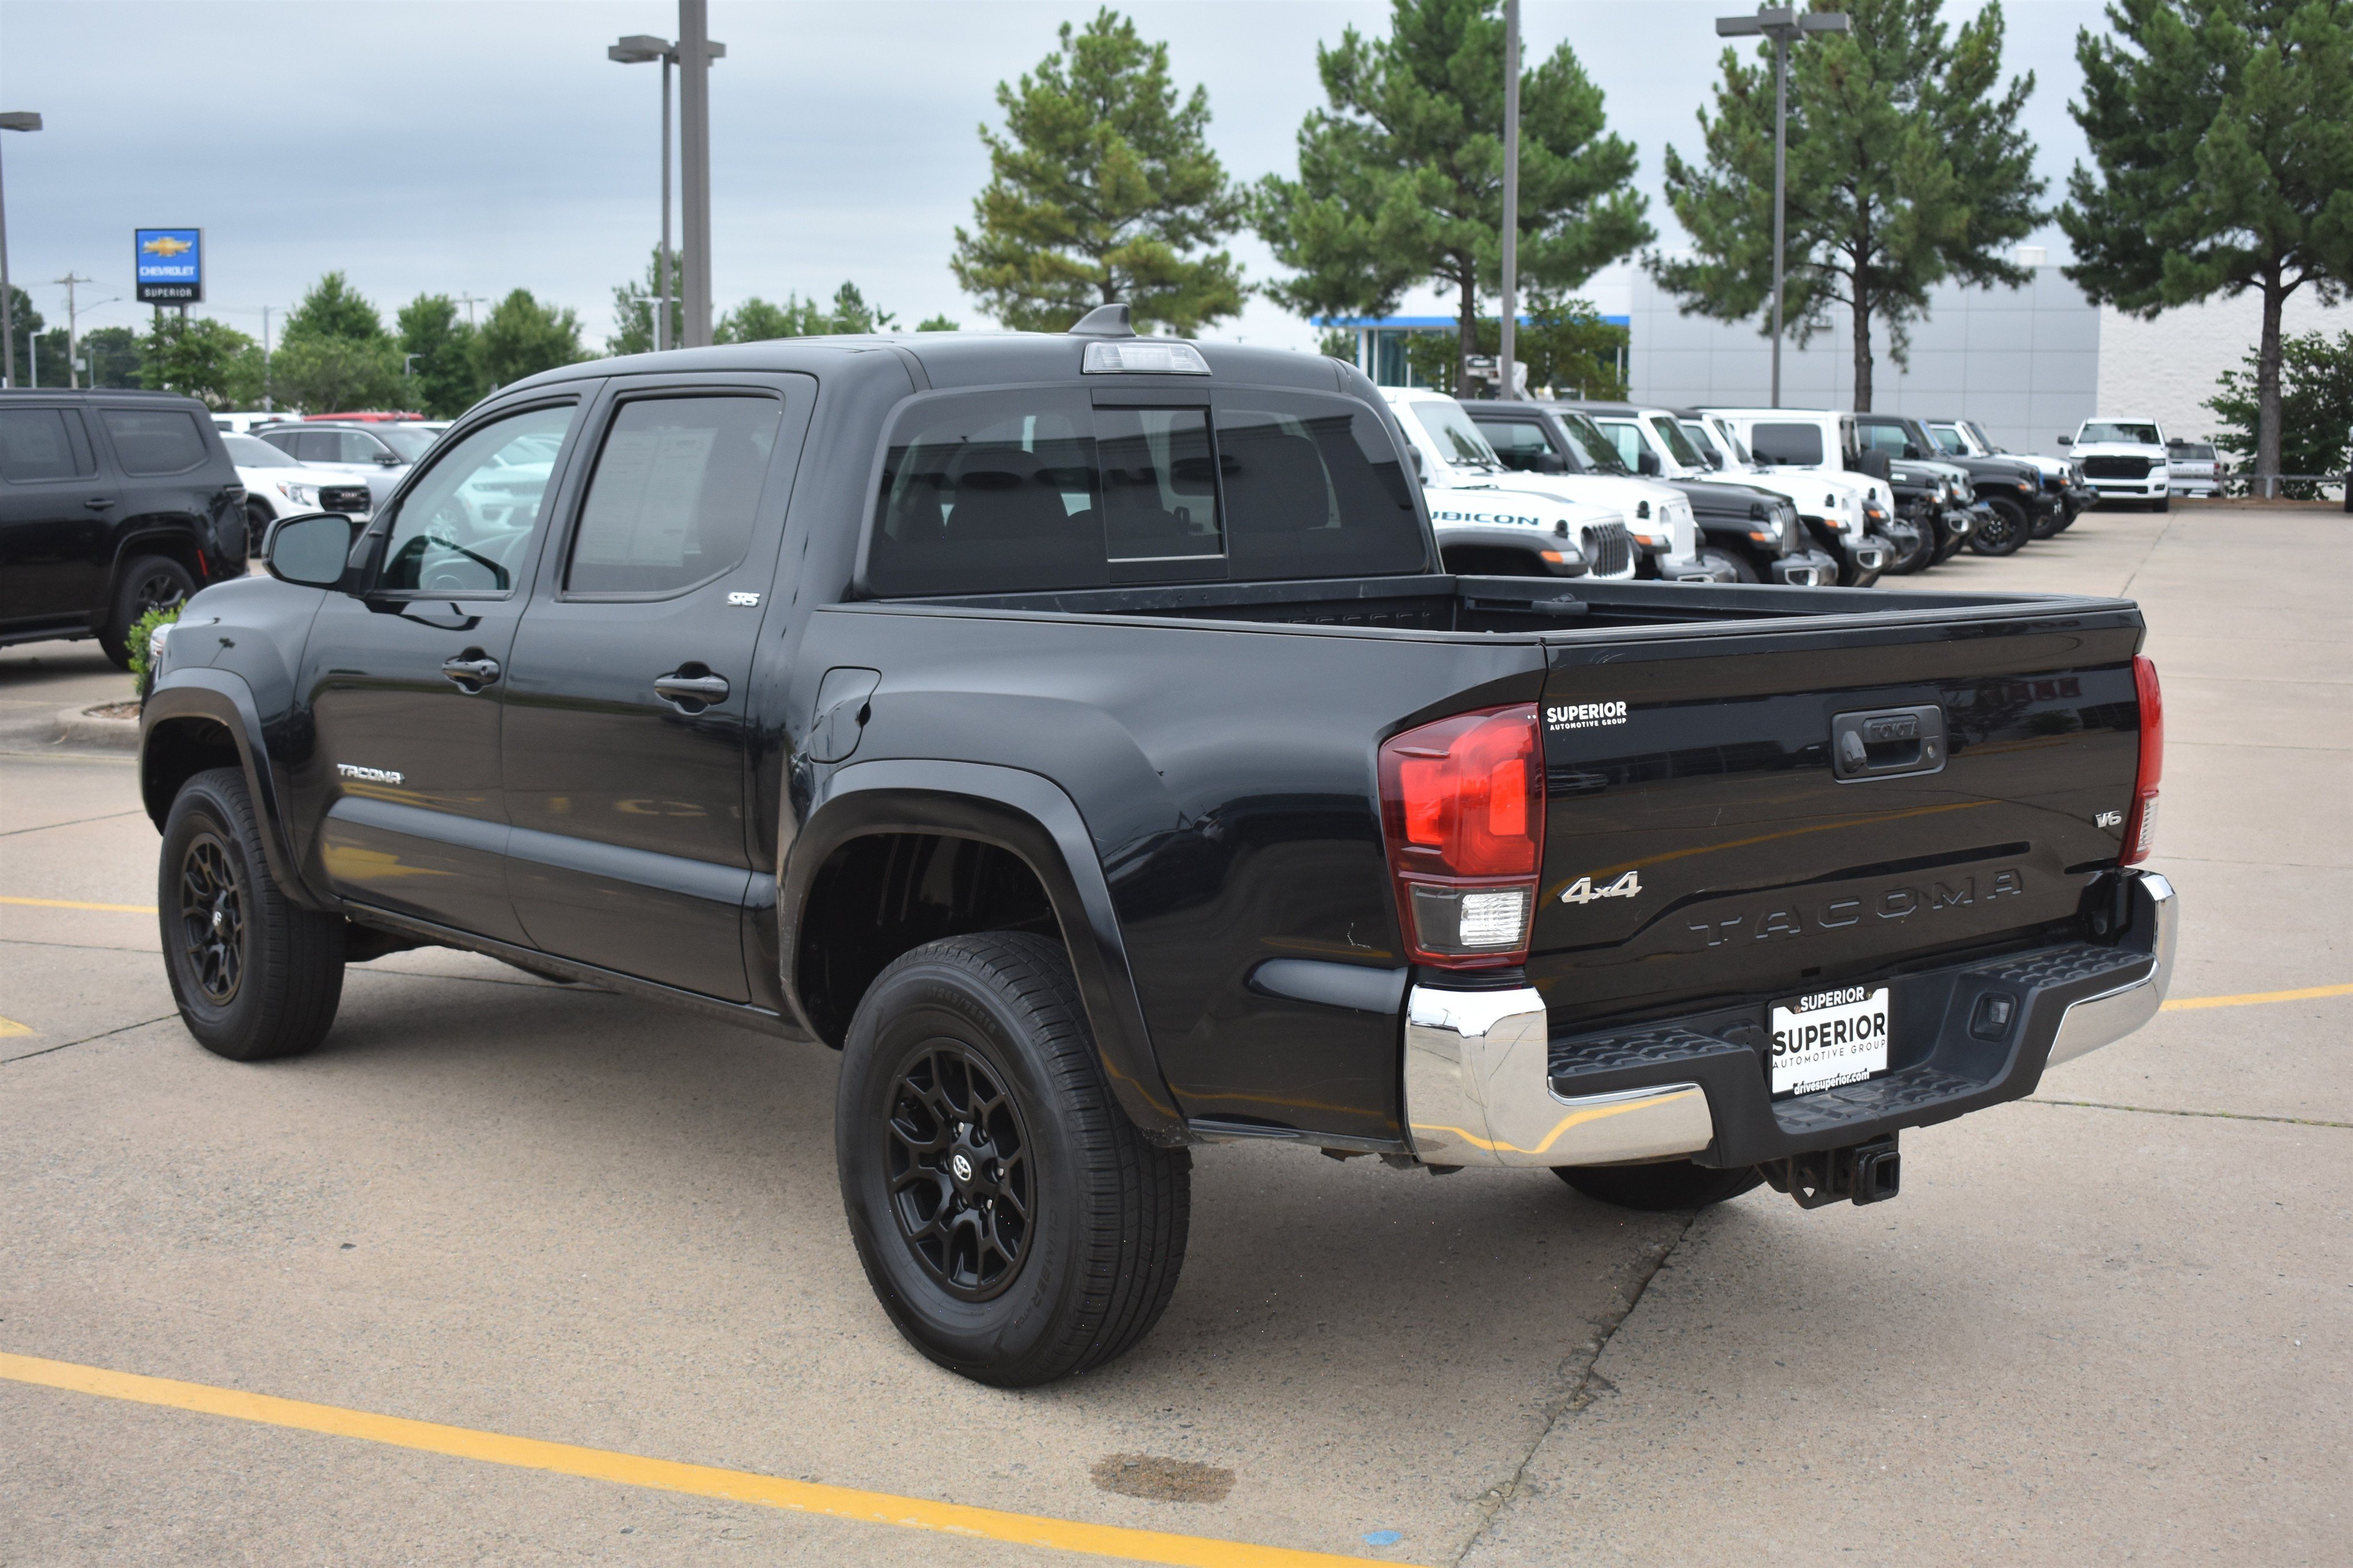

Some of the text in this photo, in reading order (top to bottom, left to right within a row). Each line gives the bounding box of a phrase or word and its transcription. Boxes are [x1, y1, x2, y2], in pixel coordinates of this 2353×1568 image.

[139, 266, 194, 276] CHEVROLET
[145, 288, 192, 298] SUPERIOR
[1432, 511, 1540, 526] BICON
[728, 592, 761, 607] SR5
[1546, 701, 1627, 723] SUPERIOR
[1550, 717, 1627, 731] AUTOMOTIVE GROUP
[337, 763, 402, 785] TACOMA
[2094, 810, 2121, 828] V6
[1558, 870, 1642, 904] 4x4
[1688, 868, 2023, 946] TACOMA
[1800, 986, 1865, 1011] SUPERIOR
[1773, 1012, 1885, 1056] SUPERIOR
[1772, 1040, 1886, 1069] AUTOMOTIVE GROUP
[1793, 1069, 1870, 1096] drivesuperior.com
